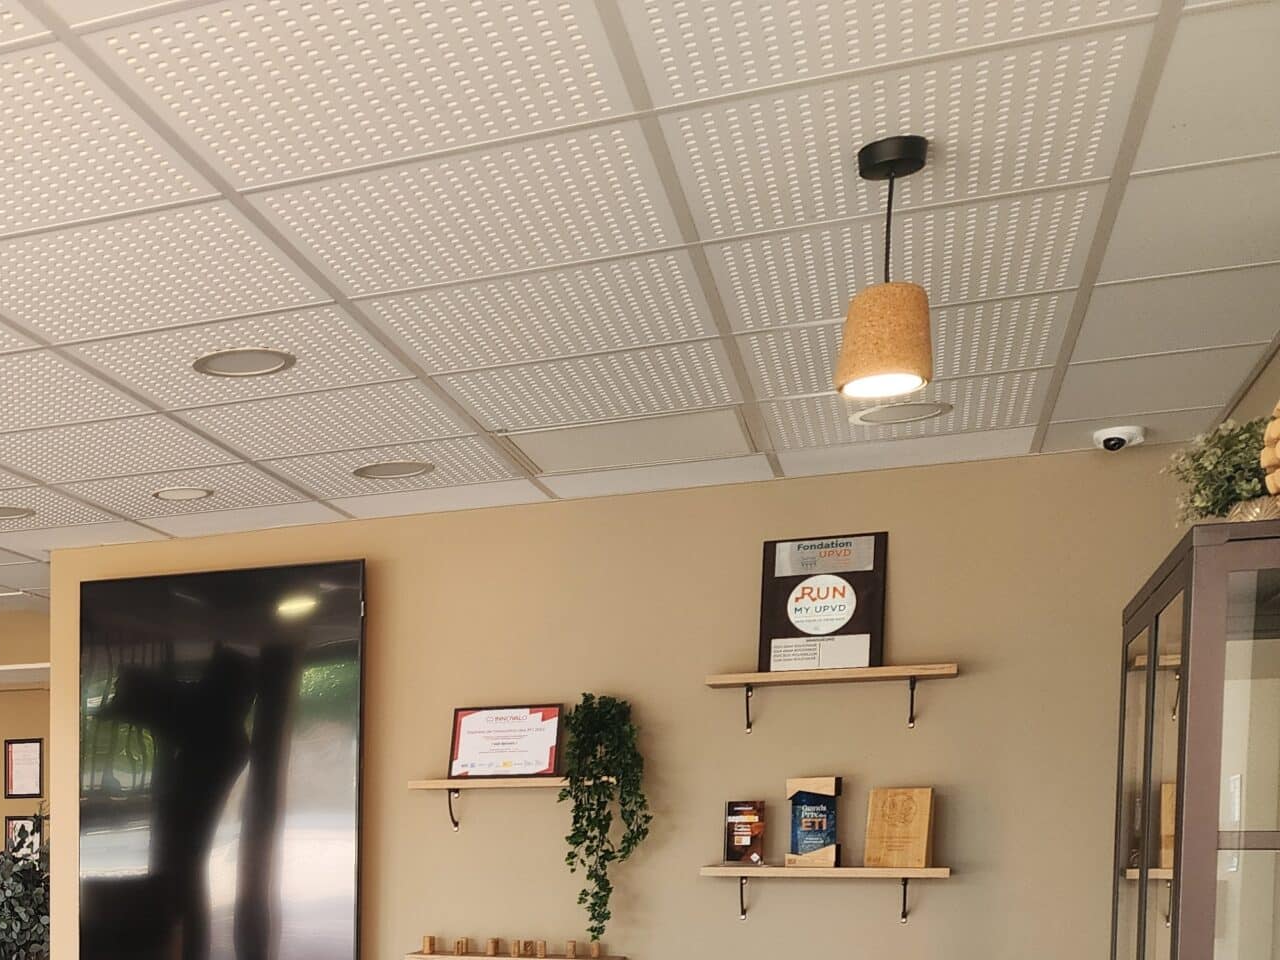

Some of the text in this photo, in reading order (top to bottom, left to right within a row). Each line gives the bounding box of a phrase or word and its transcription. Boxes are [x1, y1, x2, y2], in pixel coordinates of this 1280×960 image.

[797, 540, 852, 551] Fondation
[818, 549, 852, 558] UPVD
[794, 586, 846, 603] RUN
[794, 603, 847, 615] MY UPVD
[800, 817, 827, 831] ETI
